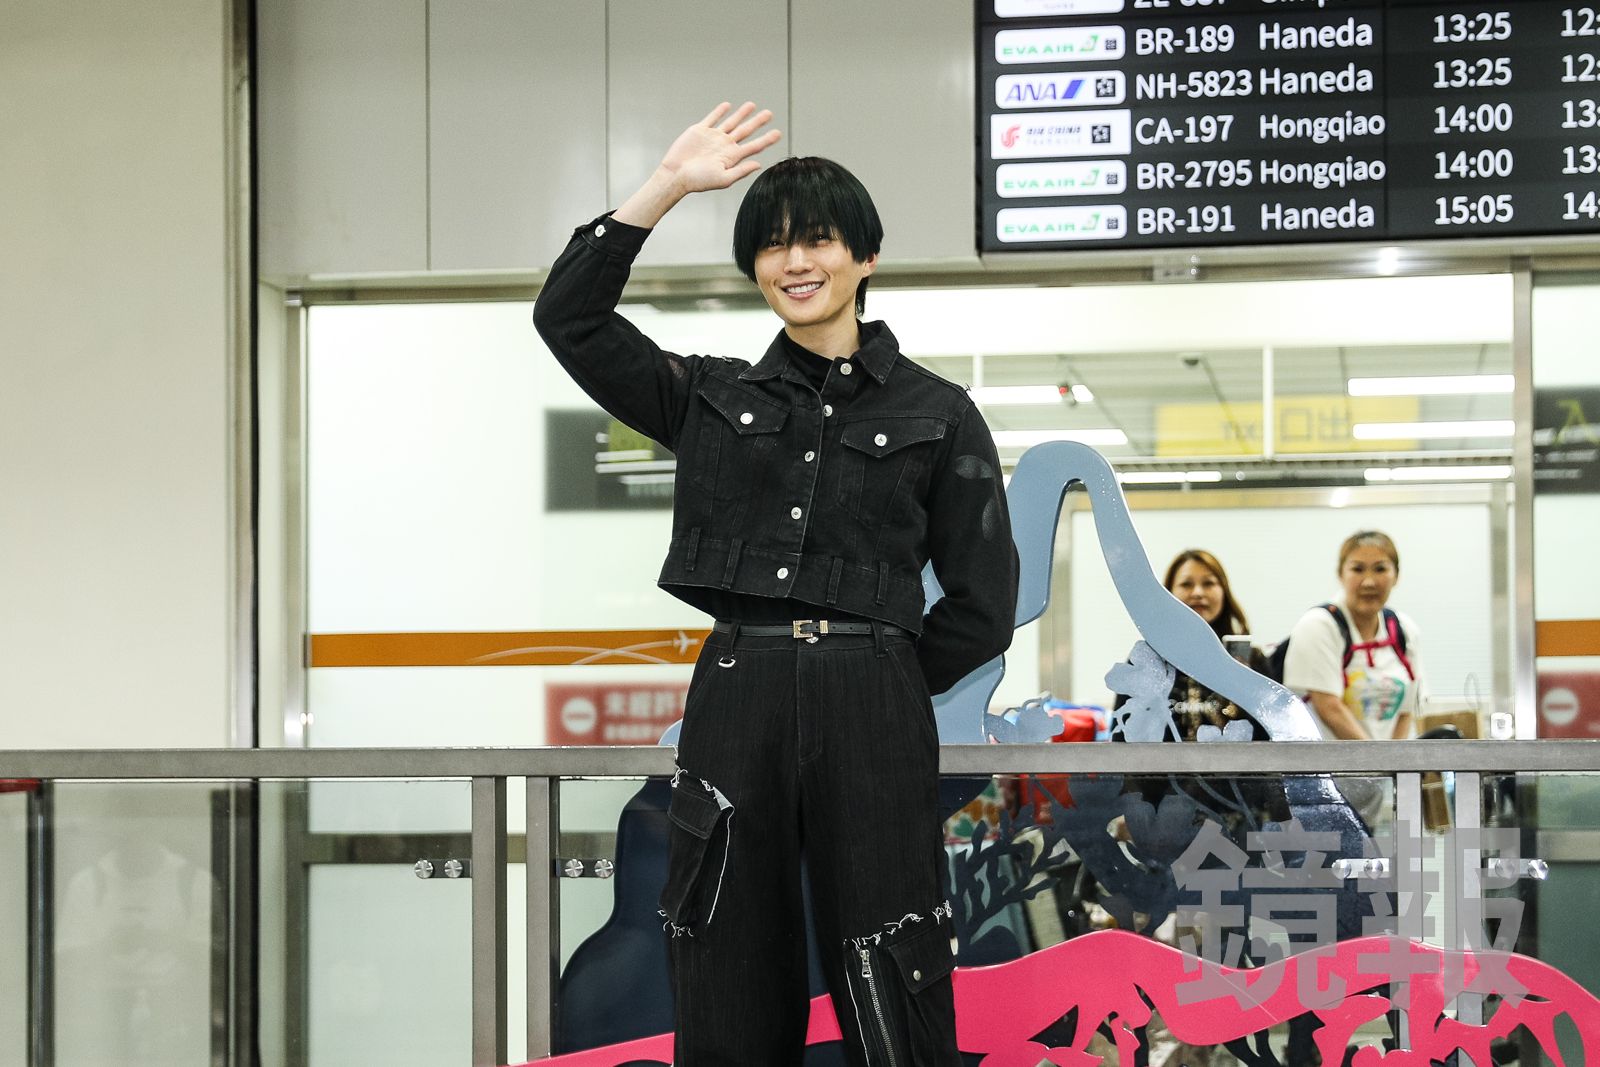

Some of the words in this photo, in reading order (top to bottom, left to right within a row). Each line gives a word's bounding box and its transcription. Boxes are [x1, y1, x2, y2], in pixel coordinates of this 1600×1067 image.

[1135, 25, 1235, 55] BR-189
[1259, 17, 1373, 50] Haneda
[1433, 12, 1512, 43] 13:25
[1005, 83, 1056, 101] ANA
[1135, 69, 1253, 100] NH-5823
[1259, 62, 1373, 96] Haneda
[1433, 58, 1512, 88] 13:25
[1134, 114, 1234, 146] CA-197
[1259, 110, 1386, 143] Hongqiao
[1434, 103, 1513, 134] 14:00
[1136, 159, 1253, 190] BR-2795
[1260, 155, 1386, 189] Hongqiao
[1434, 148, 1513, 180] 14:00
[1137, 204, 1236, 235] BR-191
[1260, 198, 1375, 231] Haneda
[1434, 194, 1514, 225] 15:05
